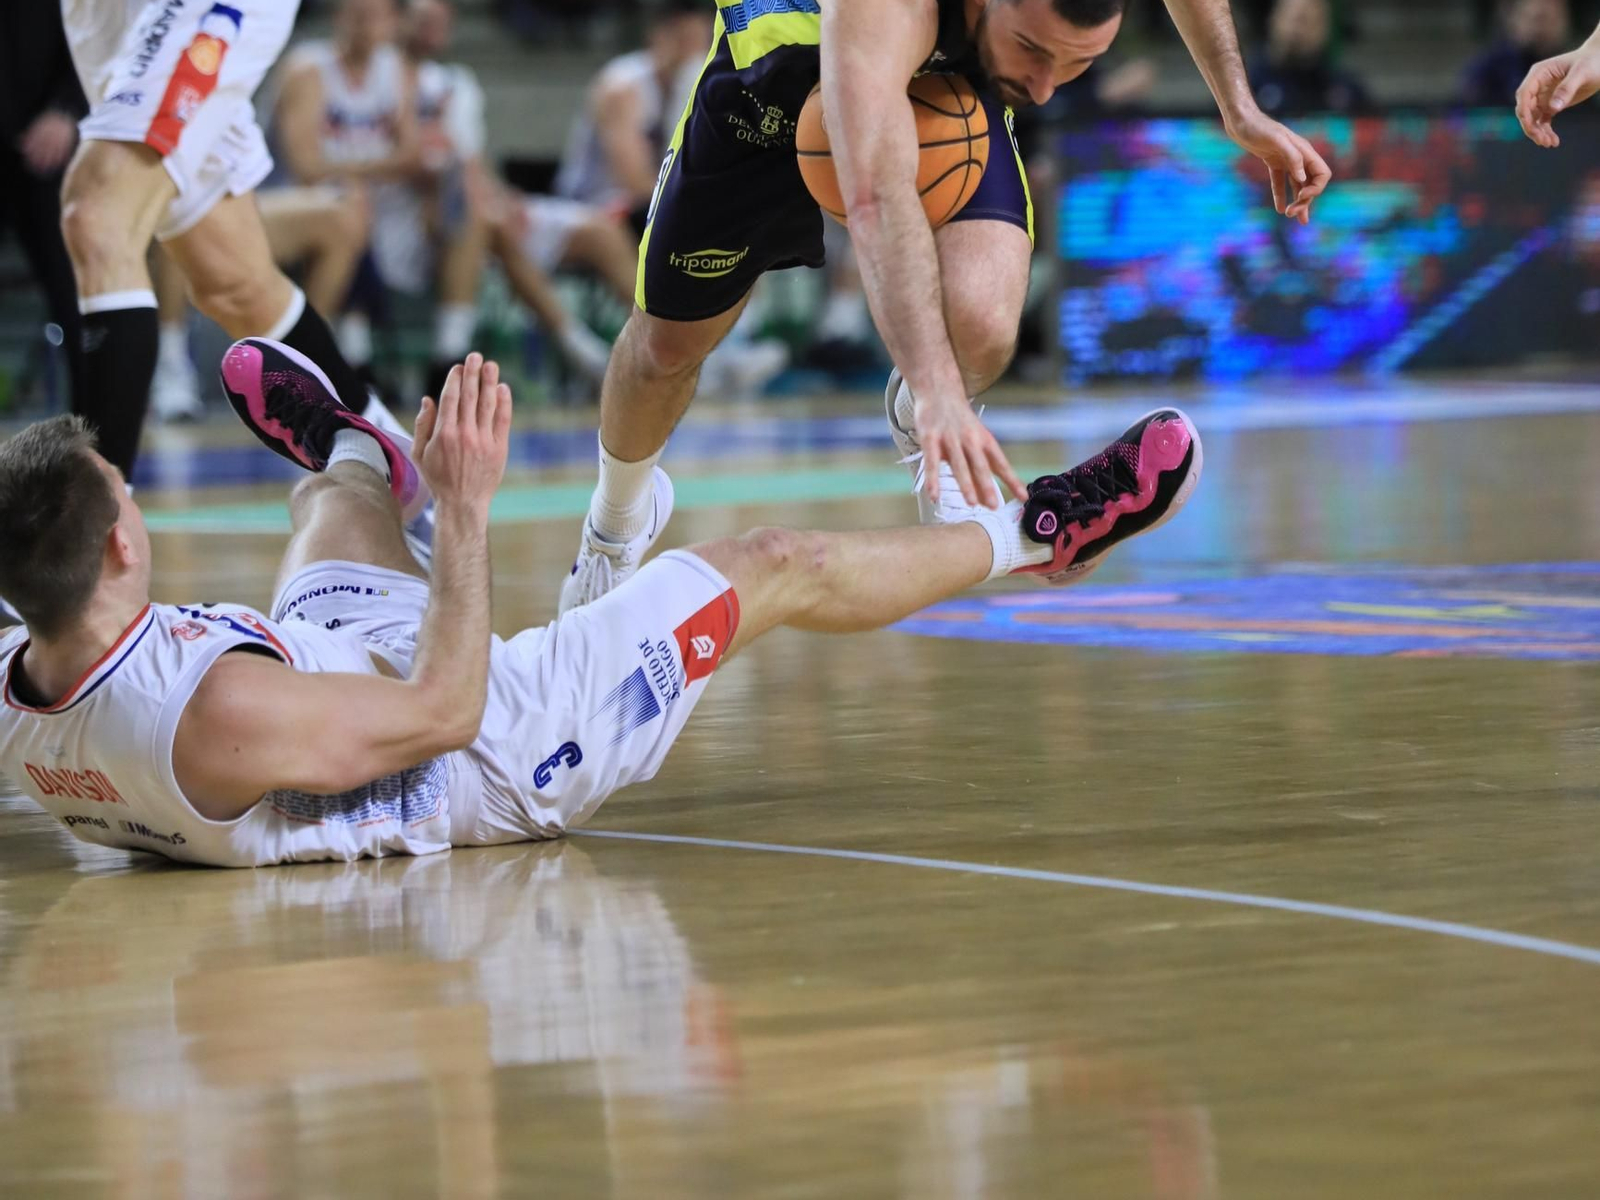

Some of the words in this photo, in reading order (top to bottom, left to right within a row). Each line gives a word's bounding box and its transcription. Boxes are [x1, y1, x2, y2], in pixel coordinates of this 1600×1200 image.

[637, 636, 655, 659] DE
[24, 762, 130, 808] DAVISON
[532, 740, 583, 790] 3
